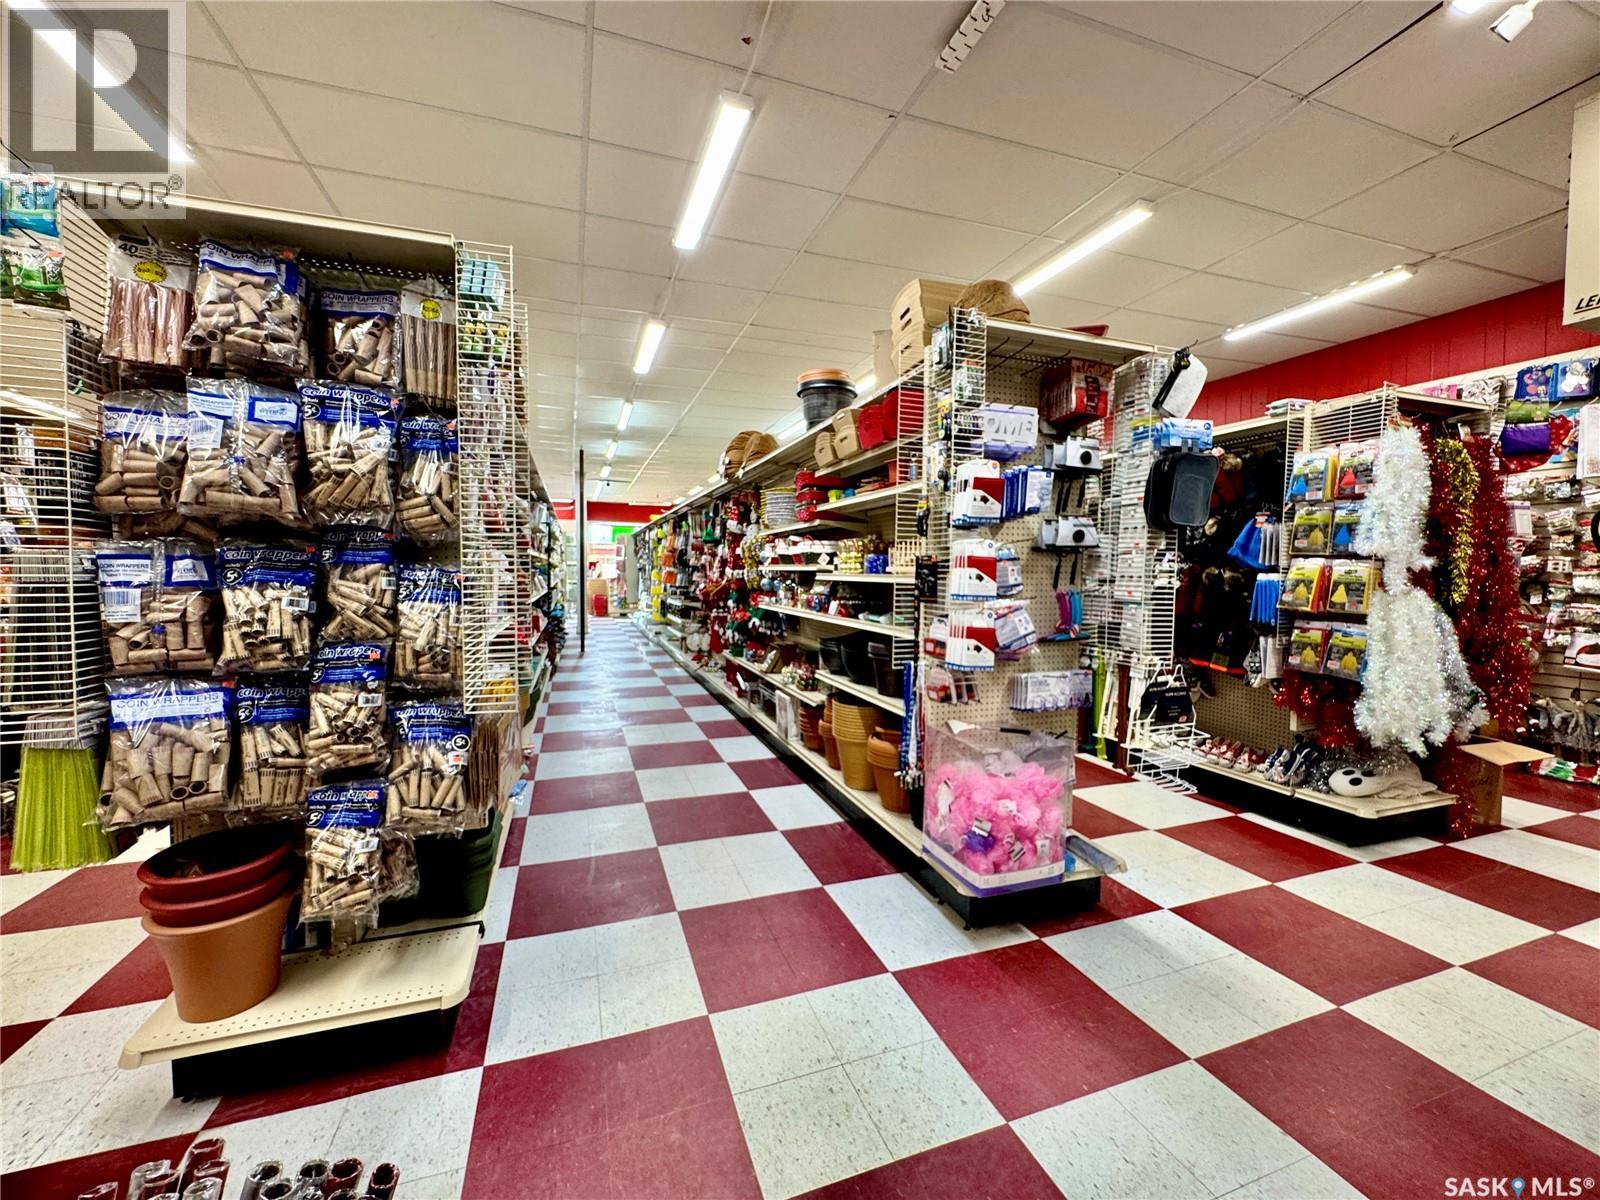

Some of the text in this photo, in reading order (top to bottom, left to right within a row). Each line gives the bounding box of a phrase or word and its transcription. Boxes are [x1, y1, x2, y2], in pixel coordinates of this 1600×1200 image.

[119, 243, 139, 254] 40
[204, 243, 228, 256] OIN
[321, 291, 345, 301] COIN
[332, 389, 389, 406] wappers
[224, 550, 312, 562] coin wrappers
[237, 687, 264, 699] coin
[116, 699, 149, 708] COIN
[312, 790, 340, 801] coin
